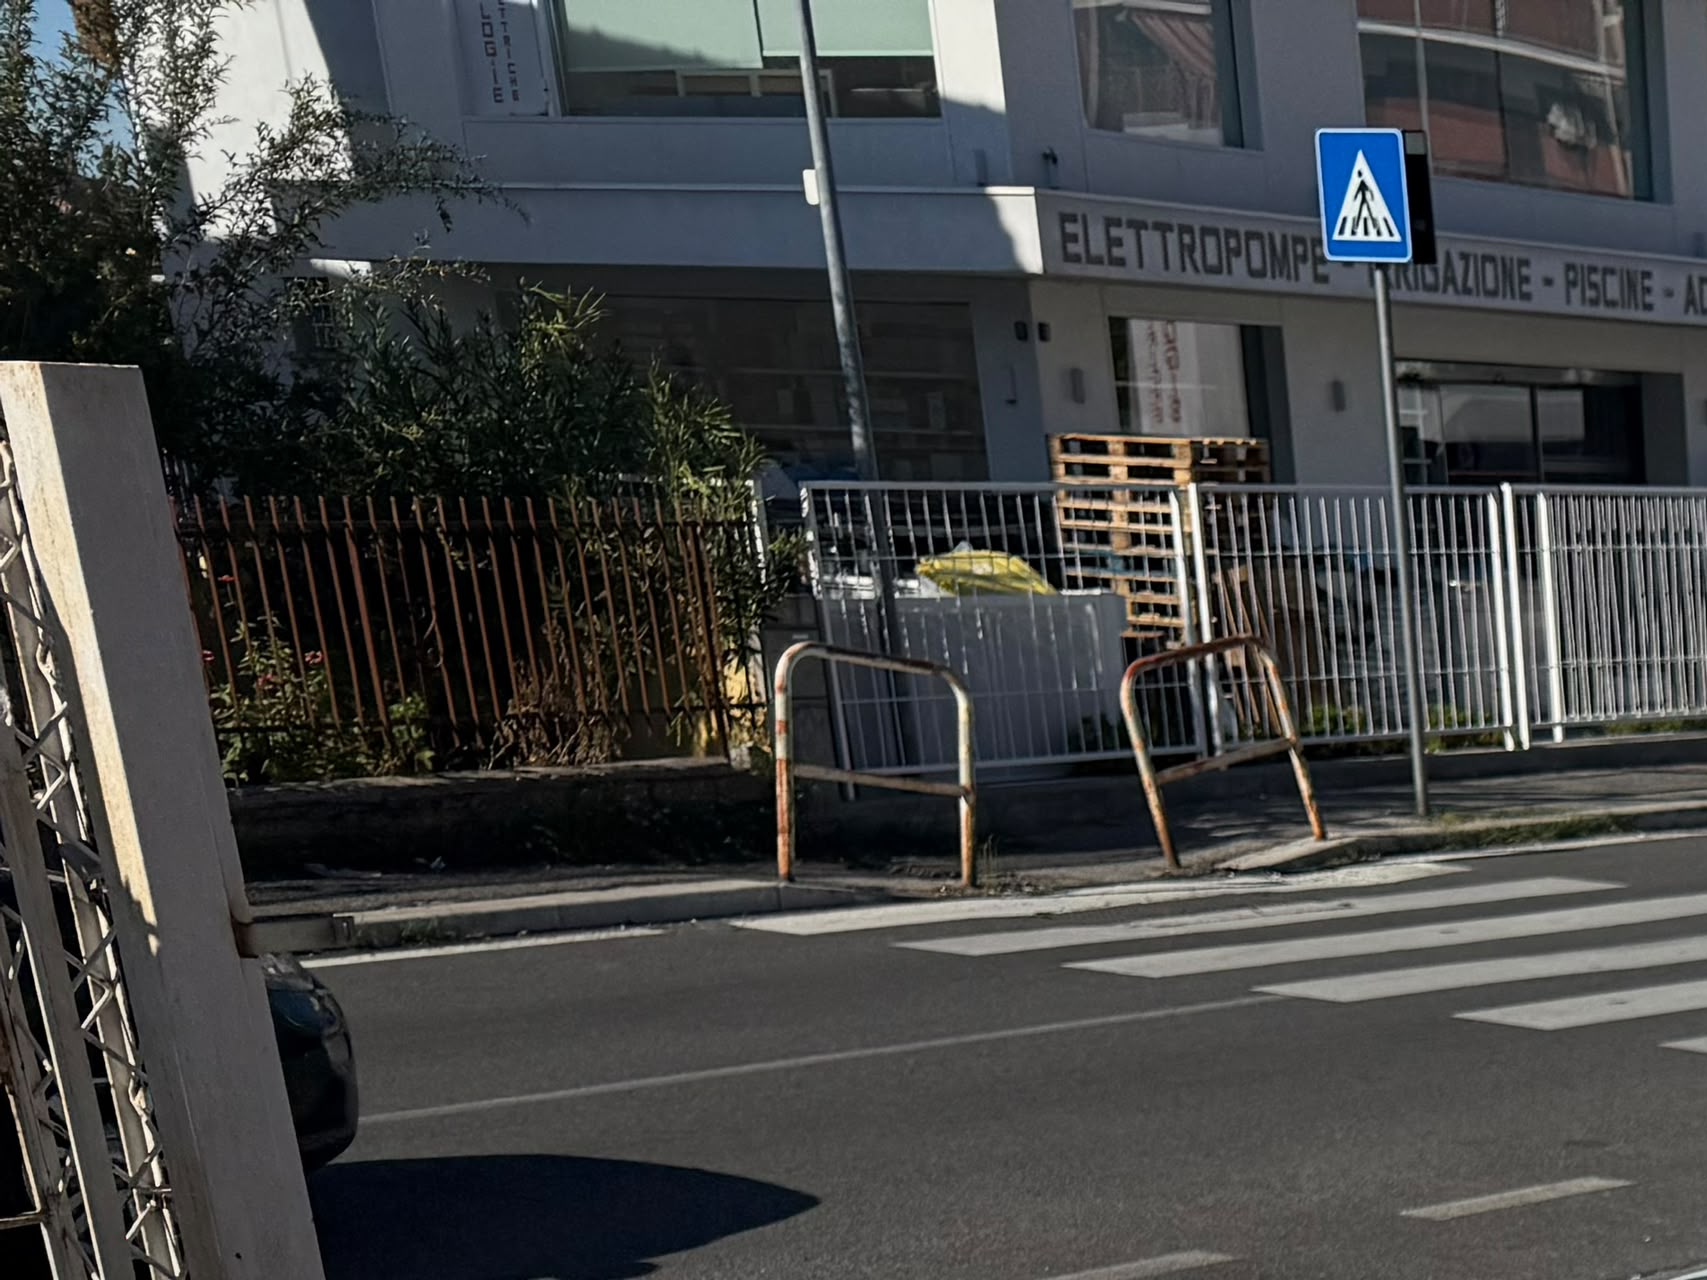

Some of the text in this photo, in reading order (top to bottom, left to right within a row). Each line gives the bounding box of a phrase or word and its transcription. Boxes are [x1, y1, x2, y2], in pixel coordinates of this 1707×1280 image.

[1058, 211, 1330, 285] ELETTROPOMPE
[1369, 249, 1533, 302] IRIGAZIONE
[1563, 262, 1655, 312] PISCINE
